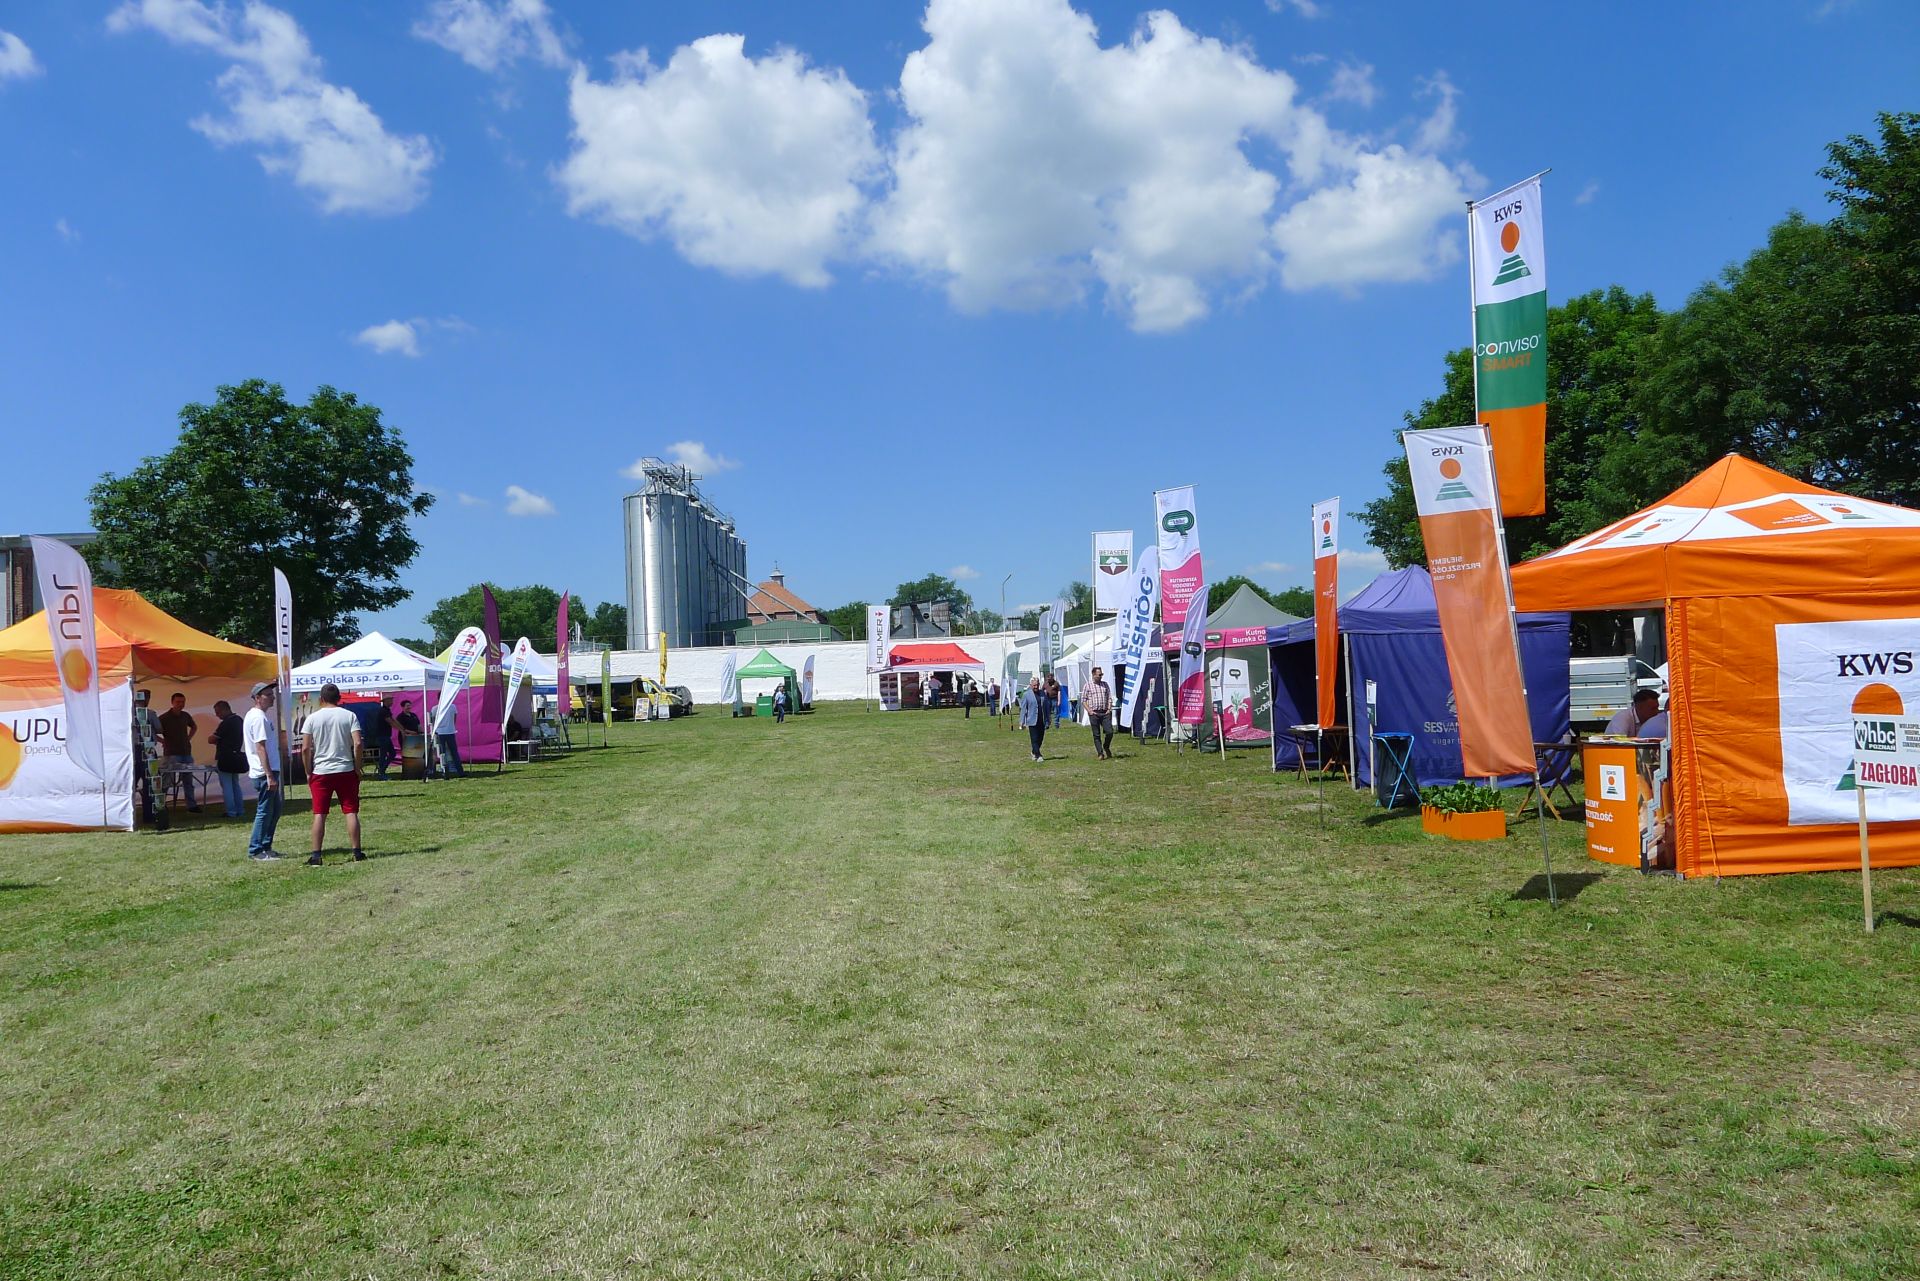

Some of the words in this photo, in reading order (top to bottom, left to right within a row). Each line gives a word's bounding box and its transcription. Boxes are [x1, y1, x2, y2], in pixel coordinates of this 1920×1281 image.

[1494, 200, 1523, 223] KWS
[1482, 352, 1532, 372] SMART
[1121, 576, 1153, 705] HILLESHÖG
[1232, 636, 1256, 644] Buraka
[1837, 651, 1914, 677] KWS
[296, 676, 316, 686] K+S
[320, 674, 353, 685] Polska
[357, 675, 372, 685] sp.
[383, 673, 403, 682] o.o.
[13, 718, 66, 743] UPL
[1424, 721, 1459, 733] SESVAN
[1860, 762, 1918, 787] ZAGŁOBA
